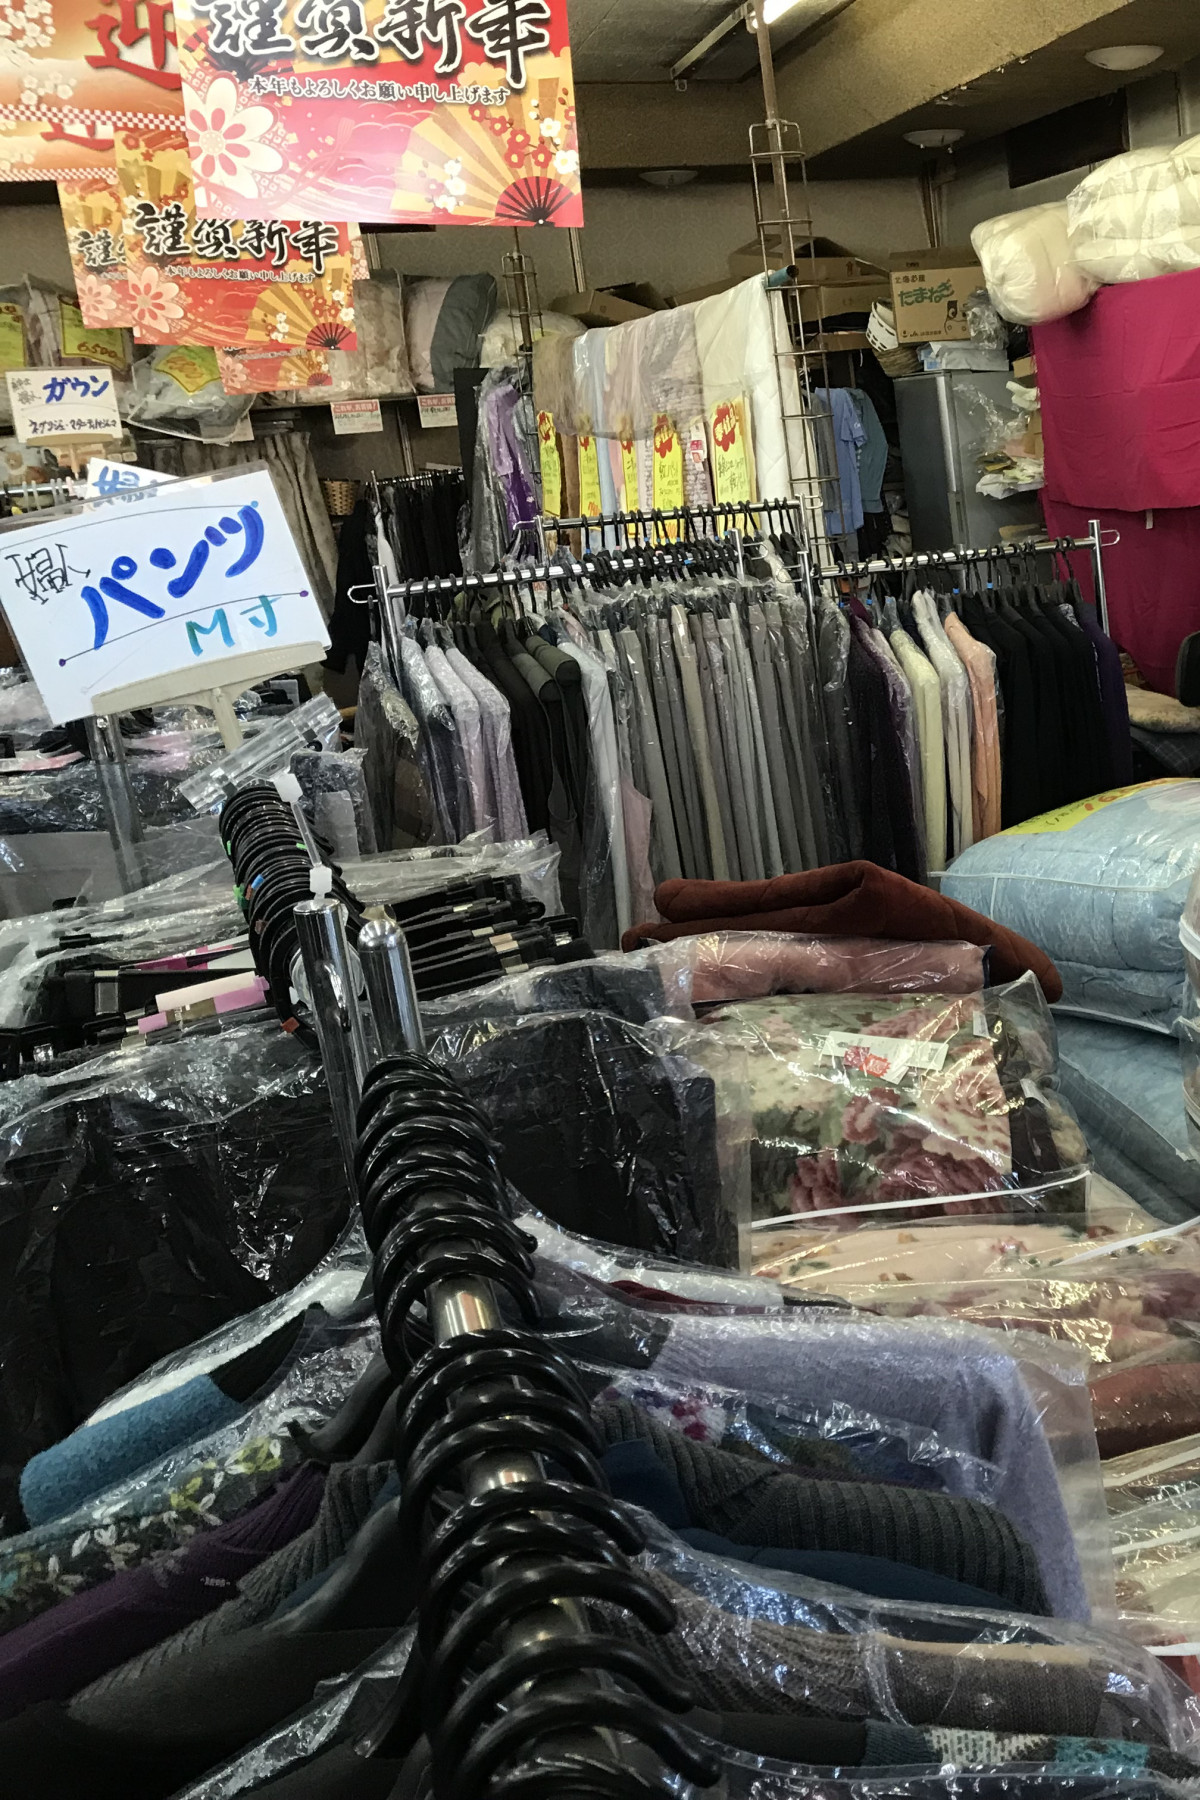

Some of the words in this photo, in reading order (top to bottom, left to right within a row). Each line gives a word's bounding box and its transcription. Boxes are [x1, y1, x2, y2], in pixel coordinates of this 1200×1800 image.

[250, 76, 510, 105] 本年もよろしくお願い申し上げます
[898, 279, 955, 307] たまねぎ
[43, 375, 109, 404] ガウン
[81, 501, 264, 650] パンツ
